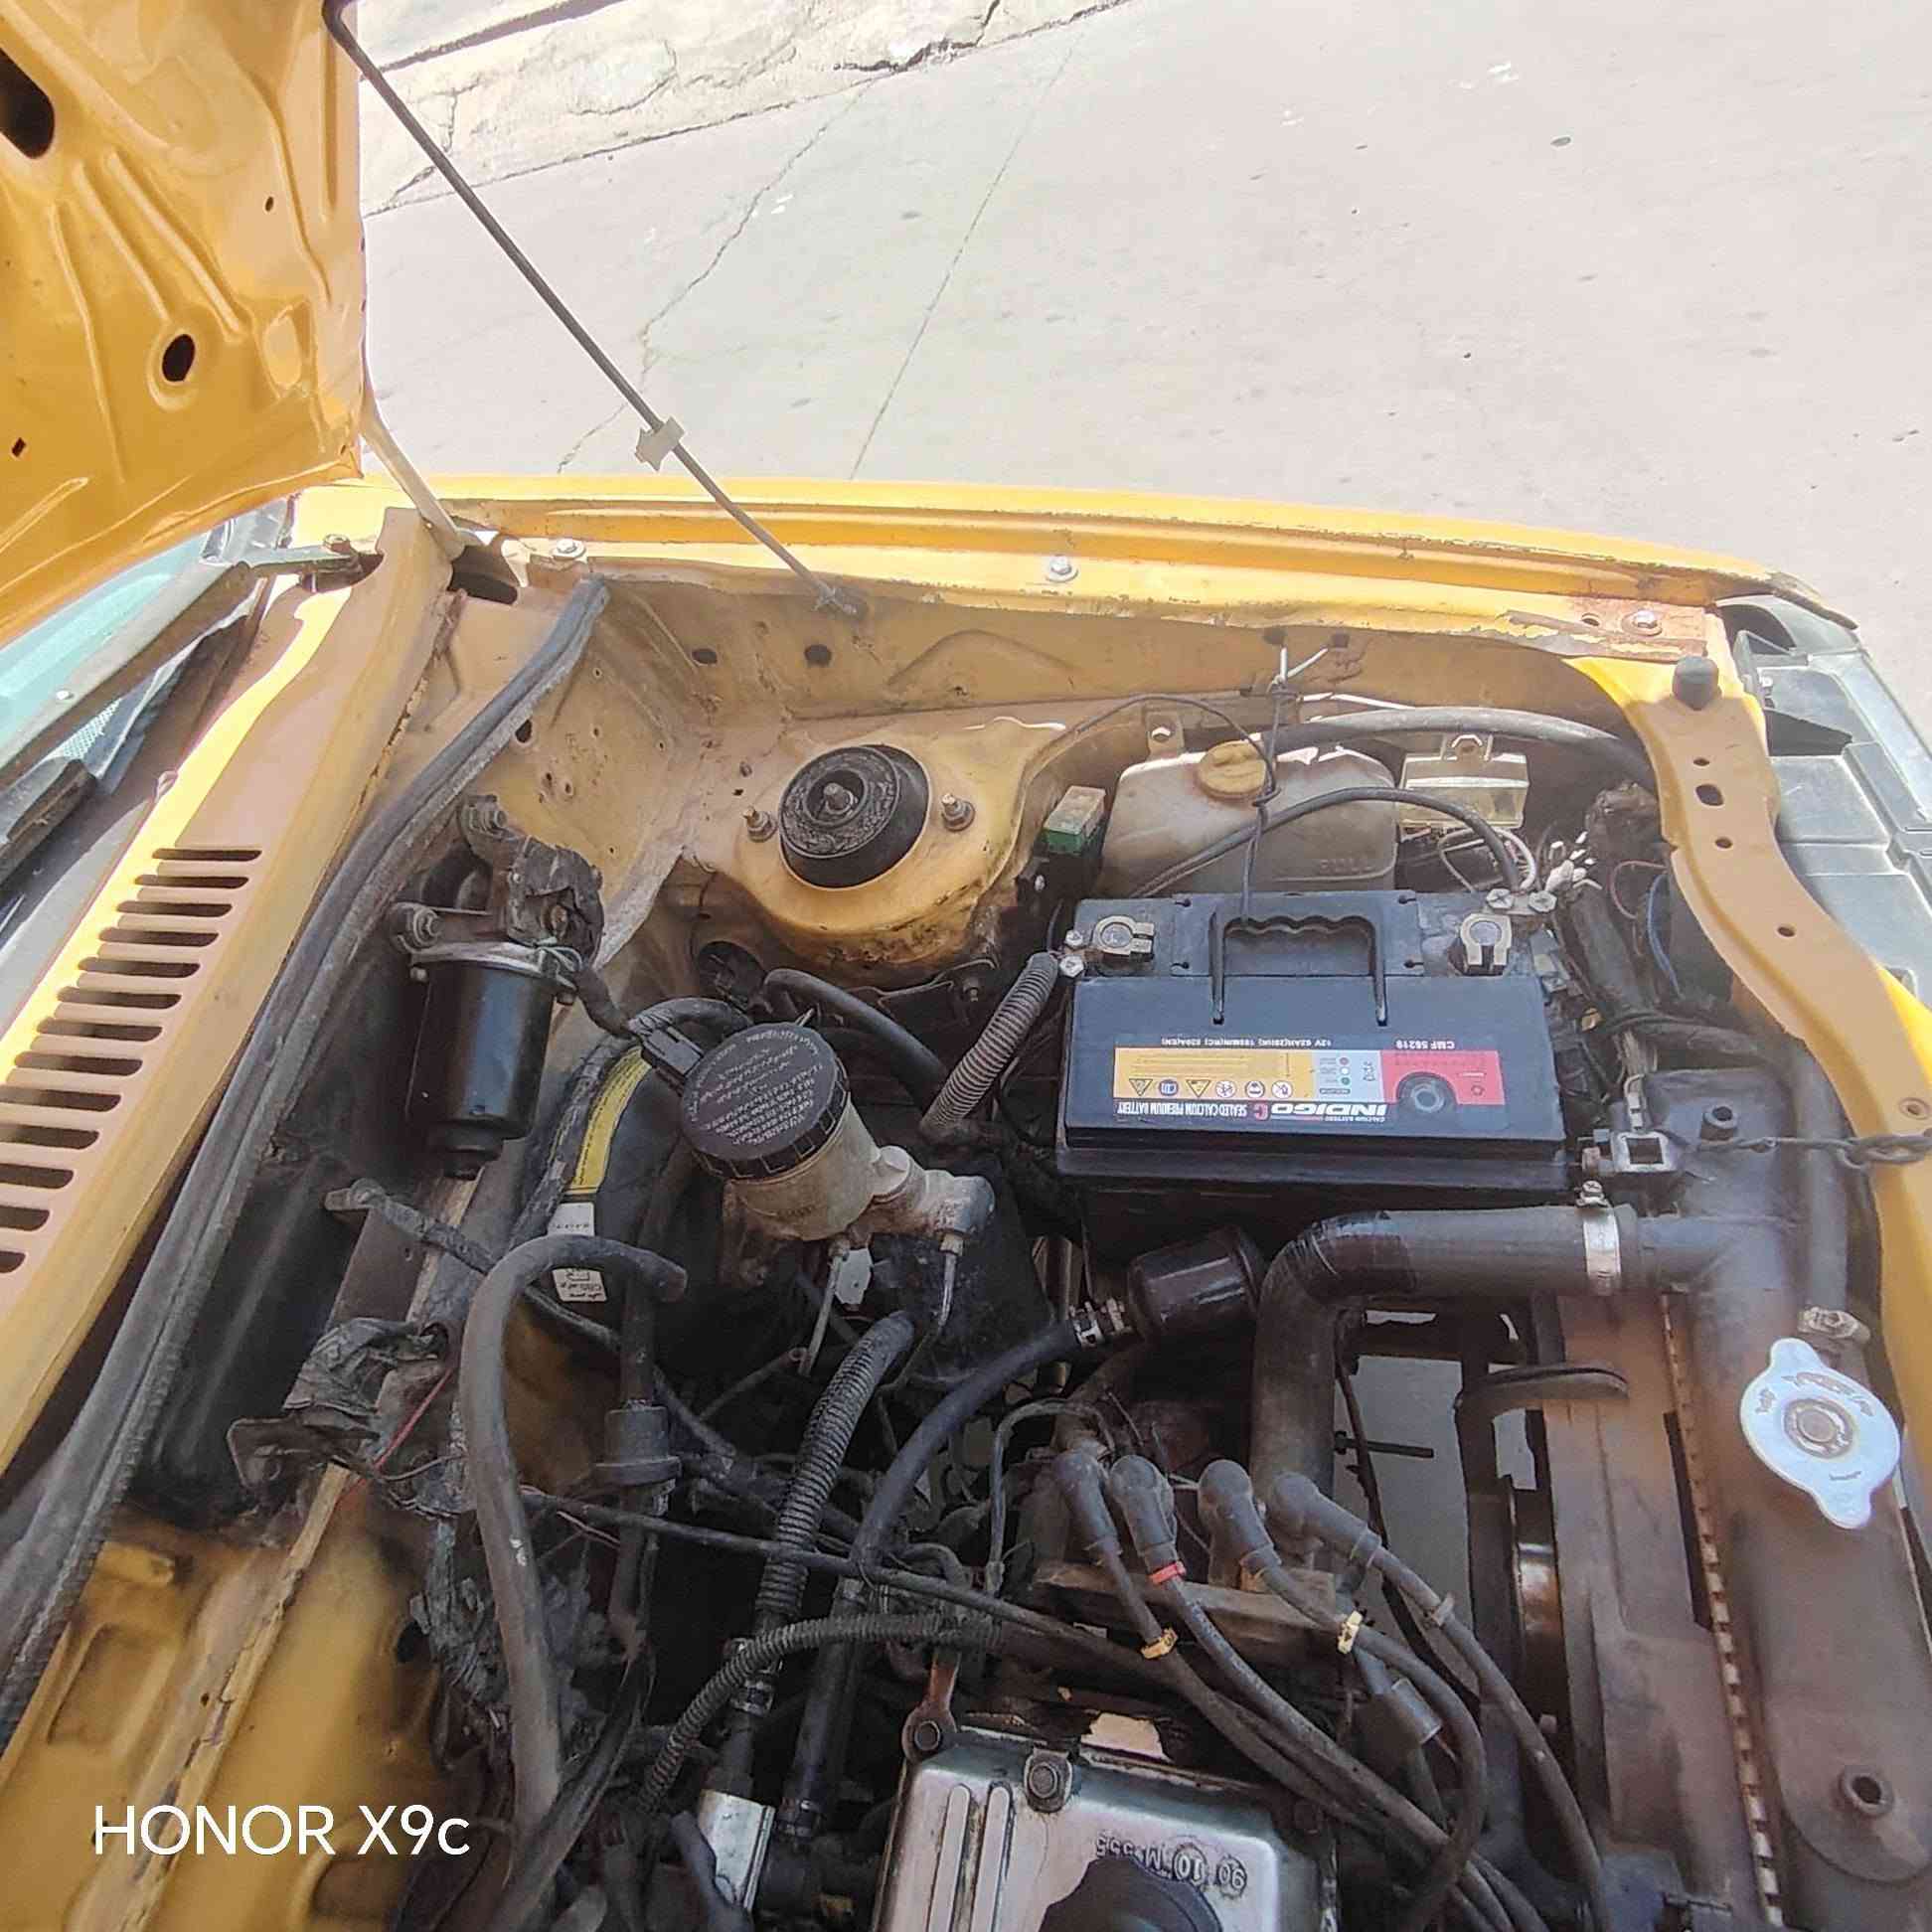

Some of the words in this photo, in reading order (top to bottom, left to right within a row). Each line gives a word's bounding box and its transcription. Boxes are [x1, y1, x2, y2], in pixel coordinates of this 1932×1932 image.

[1430, 1041, 1455, 1049] CMF
[1117, 1101, 1150, 1115] BATTERY
[1150, 1102, 1185, 1116] PREMIUM
[1185, 1102, 1218, 1117] CALCIUM
[1218, 1103, 1247, 1117] SEALED
[1253, 1102, 1269, 1120] C
[1270, 1103, 1387, 1116] INDIGO
